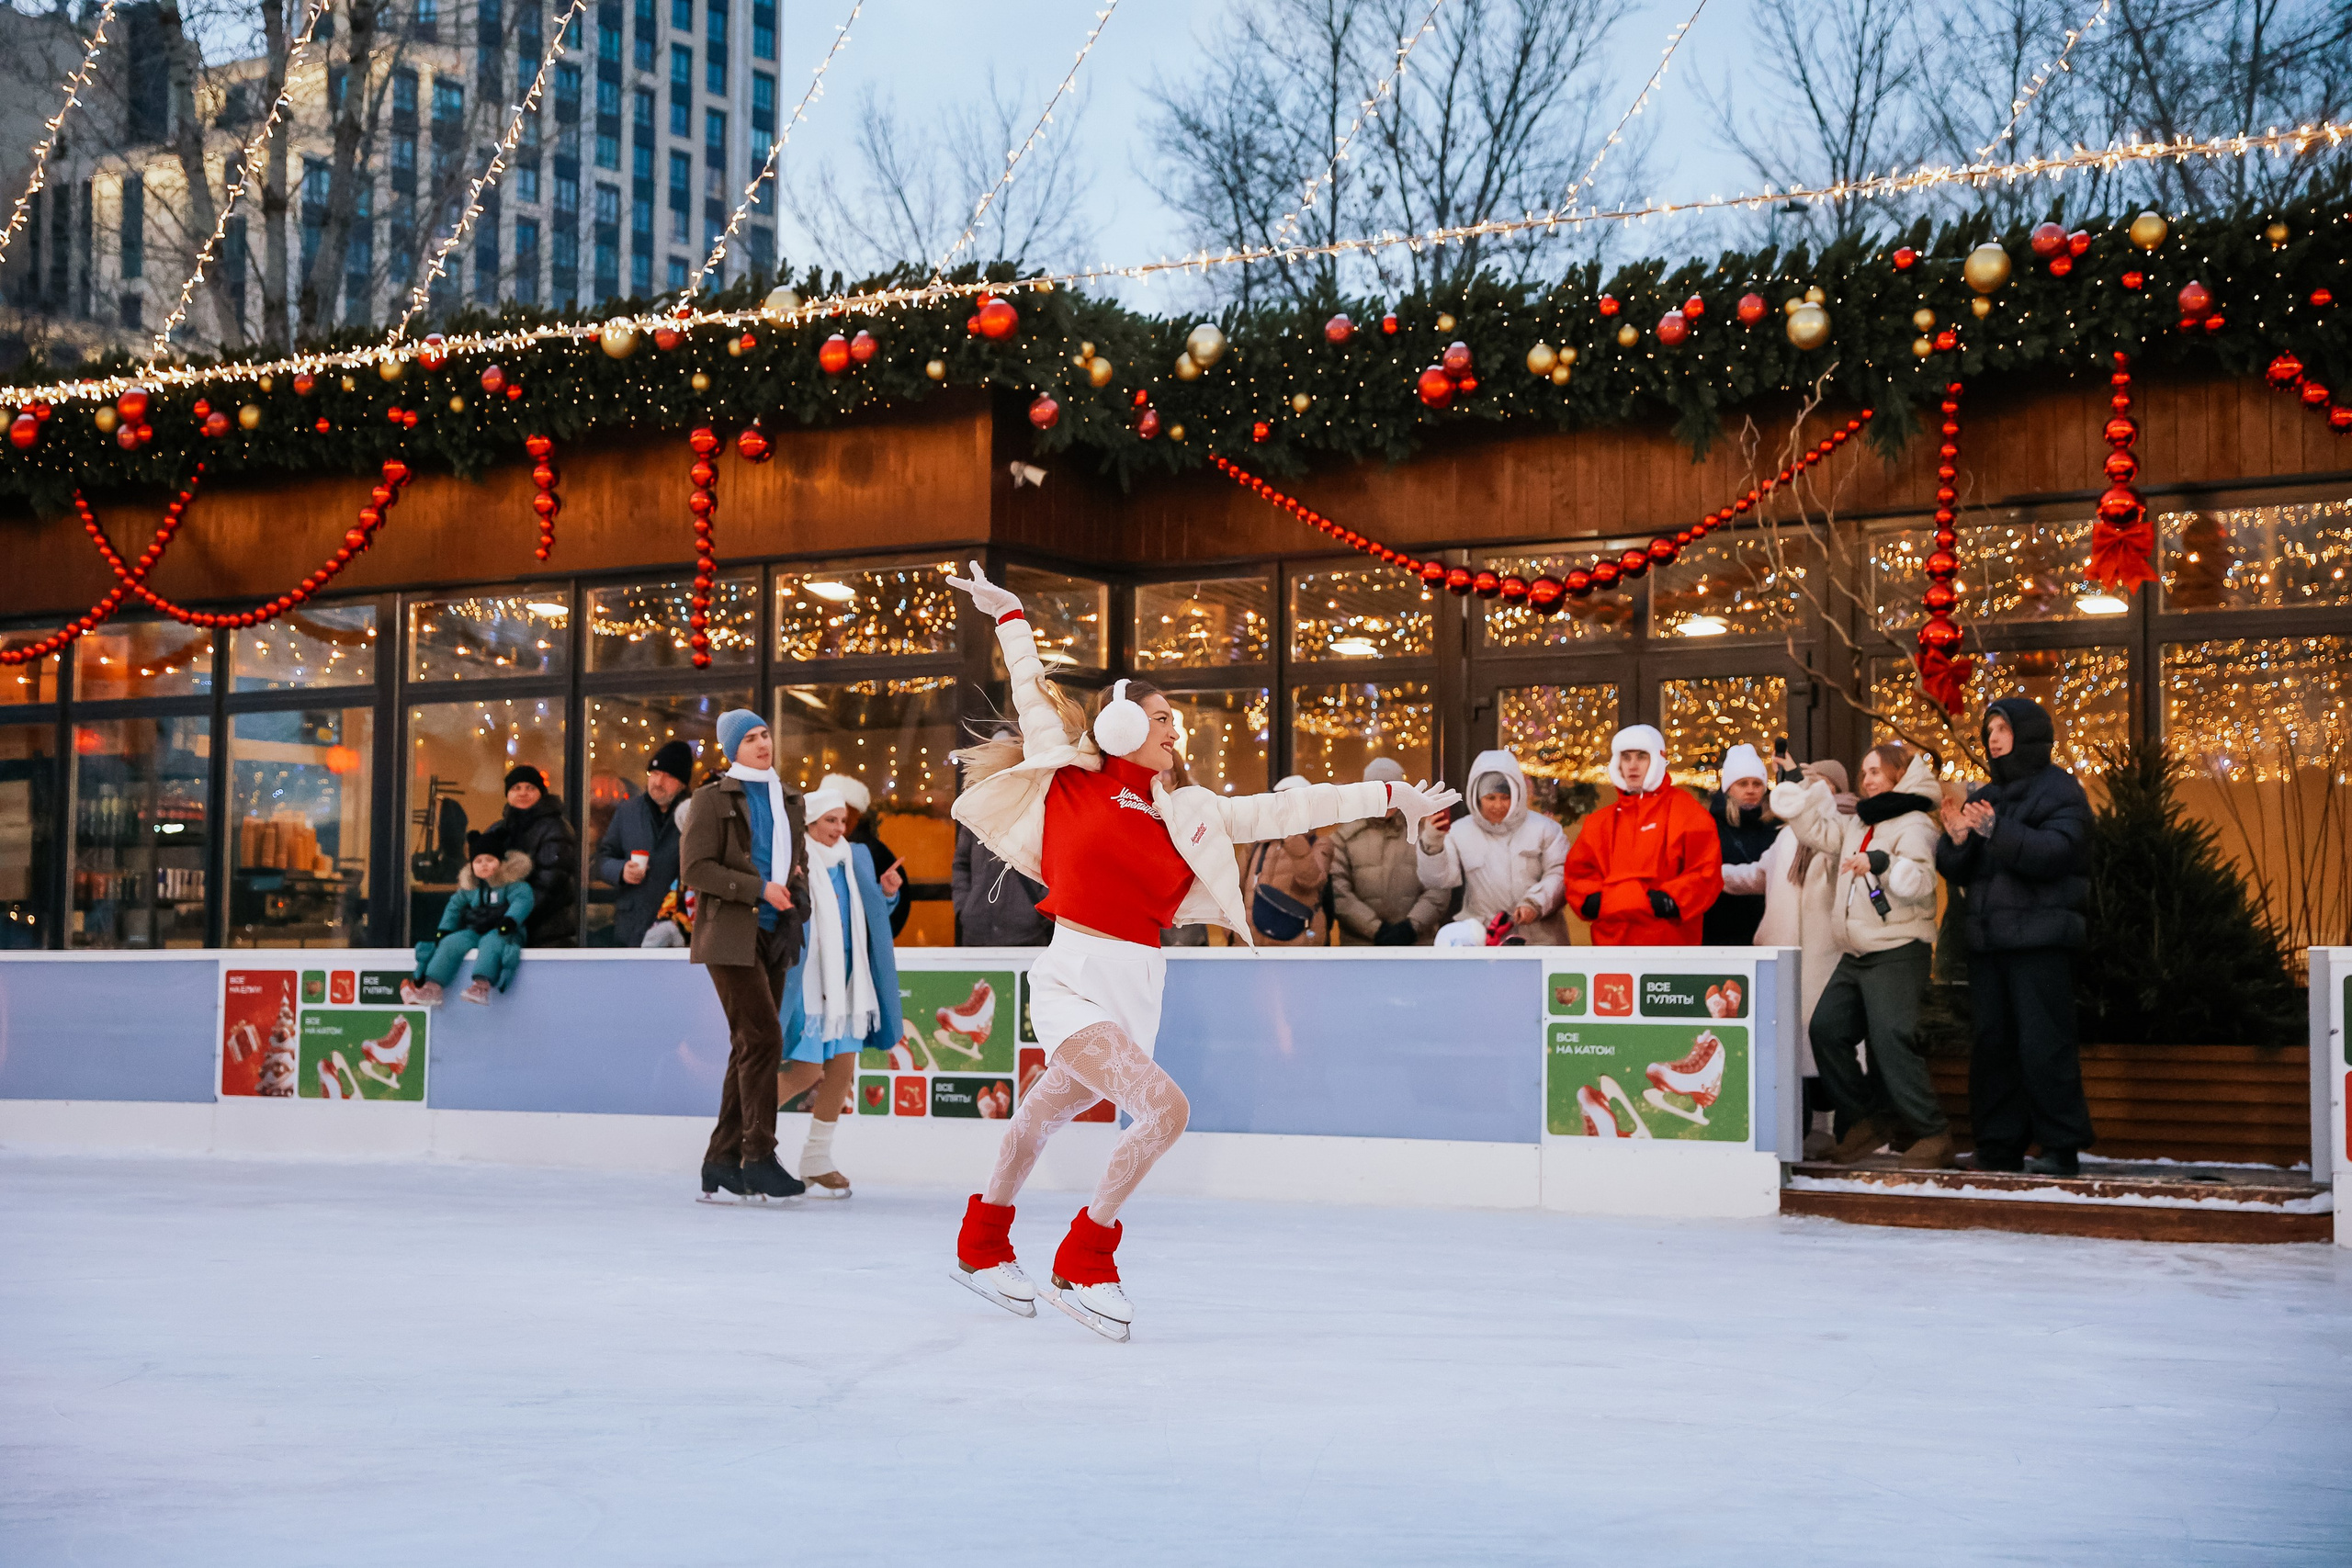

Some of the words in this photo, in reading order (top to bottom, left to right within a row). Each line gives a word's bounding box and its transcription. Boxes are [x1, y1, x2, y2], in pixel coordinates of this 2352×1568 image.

[363, 976, 379, 985] ВСЕ
[1646, 981, 1671, 992] ВСЕ
[1646, 994, 1694, 1005] ГУЛЯТЬ!
[1555, 1032, 1579, 1043] ВСЕ
[1555, 1044, 1573, 1055] НА
[1574, 1045, 1615, 1055] КАТОК!
[935, 1083, 954, 1092] ВСЕ
